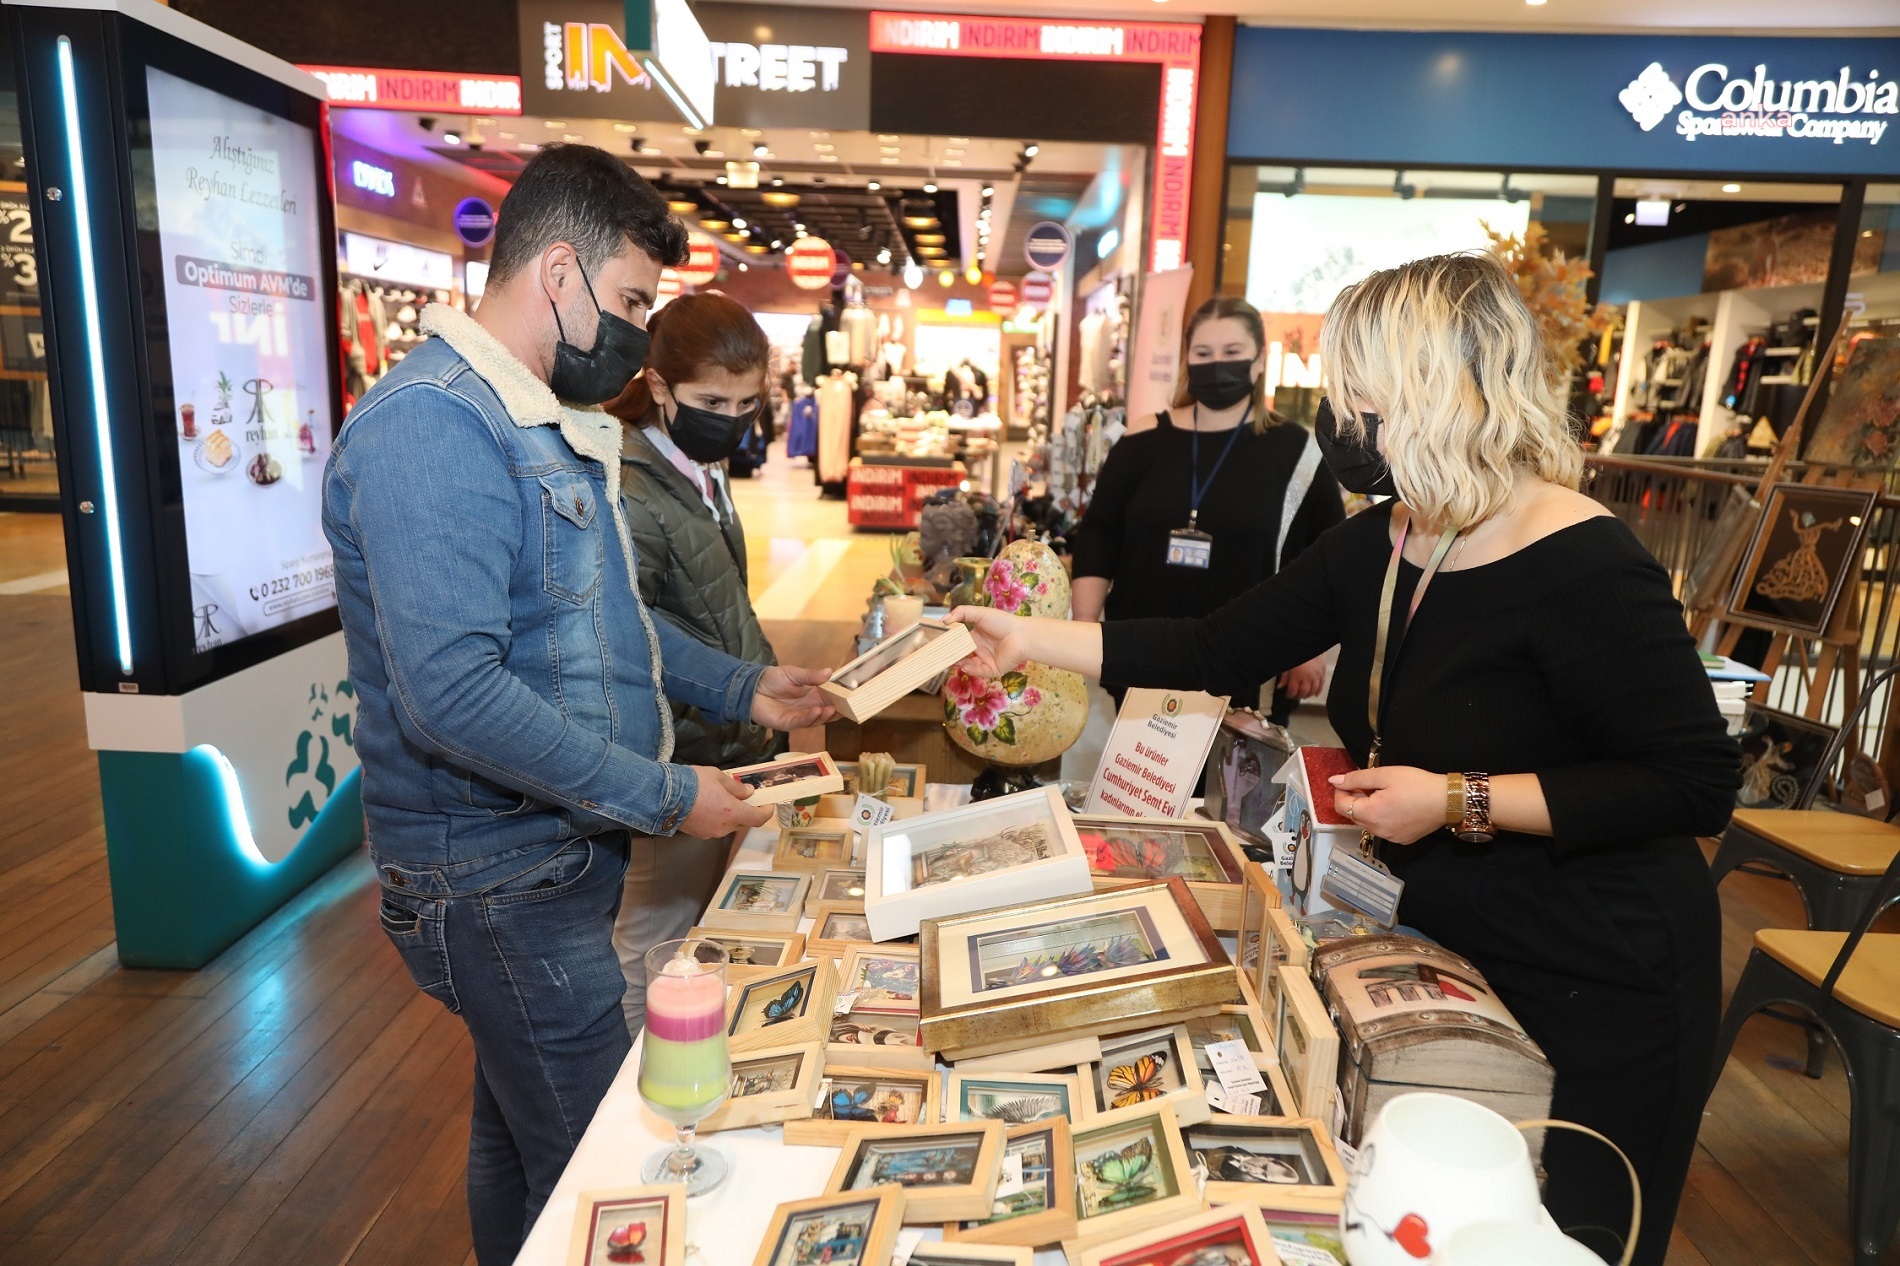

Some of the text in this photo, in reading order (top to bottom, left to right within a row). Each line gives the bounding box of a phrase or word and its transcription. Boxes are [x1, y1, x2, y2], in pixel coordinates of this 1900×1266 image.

[543, 20, 564, 91] SPORT
[709, 41, 848, 92] TREET
[1685, 63, 1899, 114] Columbia
[1786, 112, 1888, 145] Company
[186, 166, 237, 201] Reyhan
[184, 260, 308, 297] Optimum AVM'de
[261, 583, 269, 598] 0
[271, 577, 291, 595] 232
[292, 571, 313, 589] 700
[1147, 720, 1177, 740] Belediyesi
[1152, 713, 1178, 730] Gaziemir
[1135, 741, 1169, 767] Bu ürünler
[1114, 753, 1177, 794] Gaziemir Belediyesi
[1100, 788, 1135, 817] kadınlarının
[1102, 767, 1177, 818] Cumhuriyet Semt Evi
